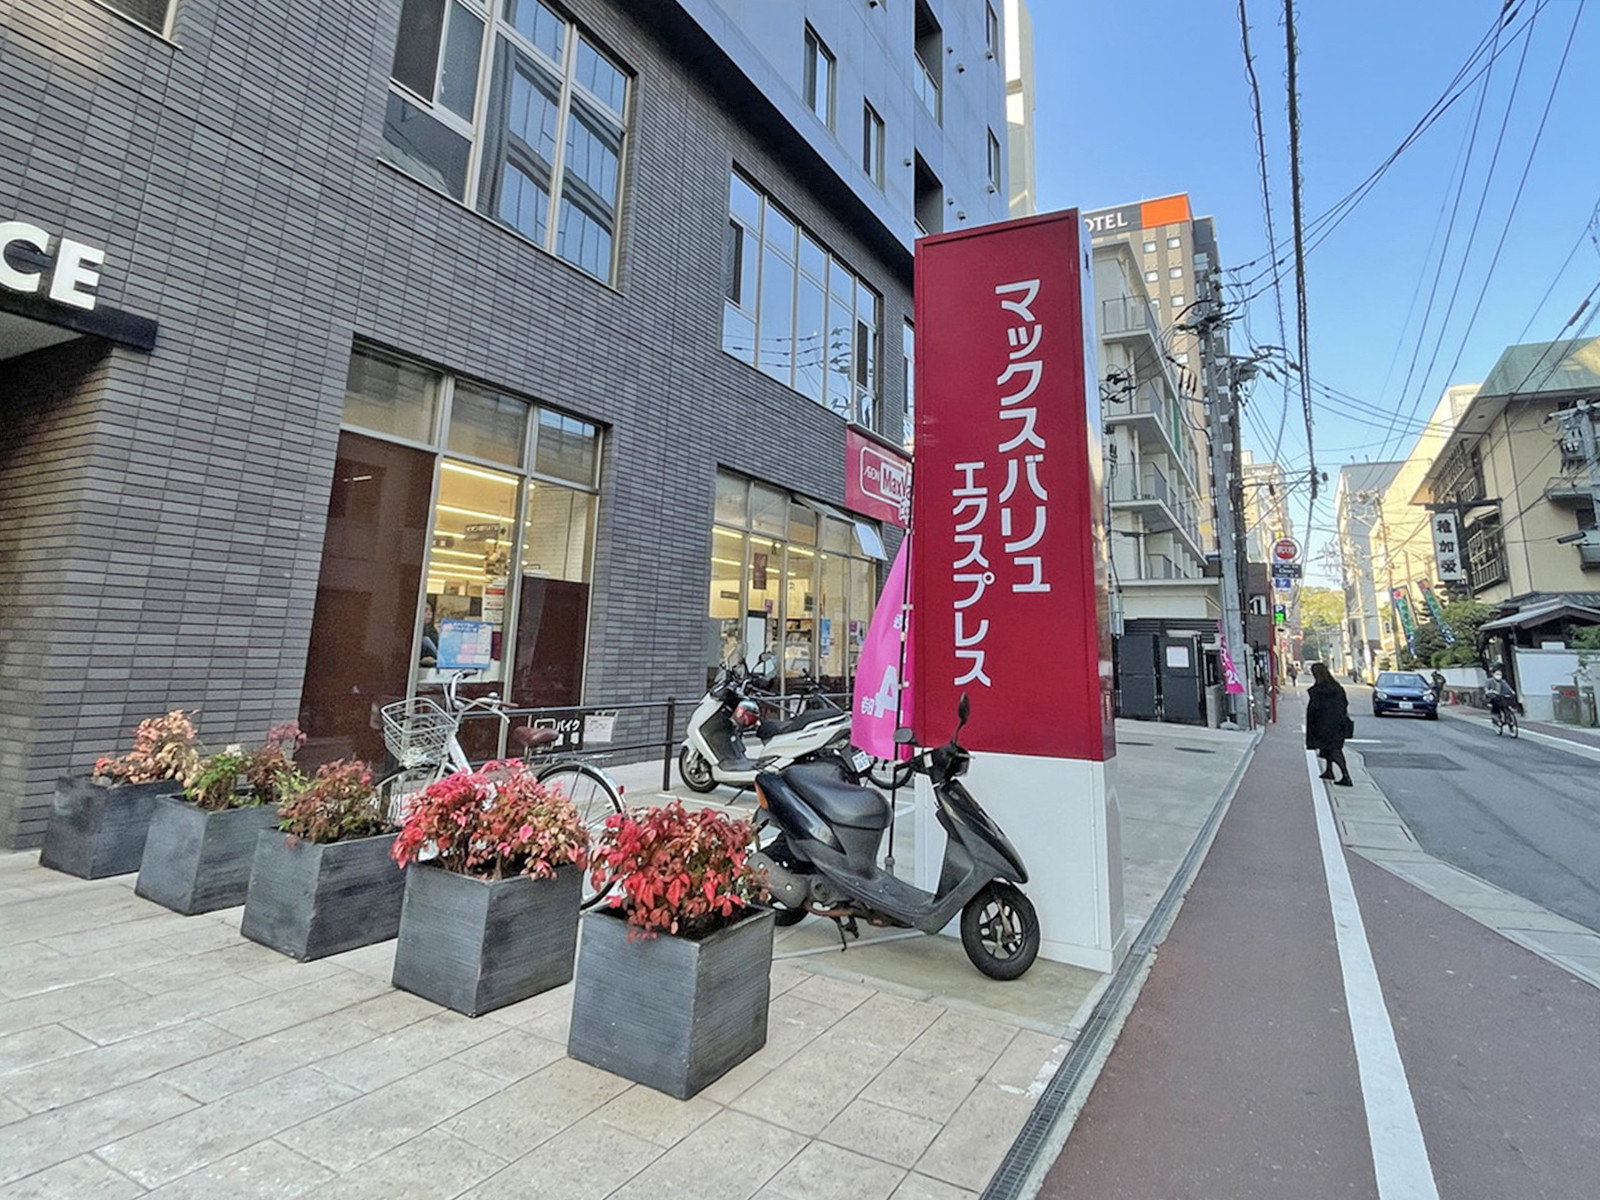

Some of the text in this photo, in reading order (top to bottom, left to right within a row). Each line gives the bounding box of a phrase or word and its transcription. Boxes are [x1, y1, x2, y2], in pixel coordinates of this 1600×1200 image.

[0, 221, 105, 310] CE
[995, 278, 1051, 593] マックスバリュ
[952, 461, 996, 688] エクスプレス
